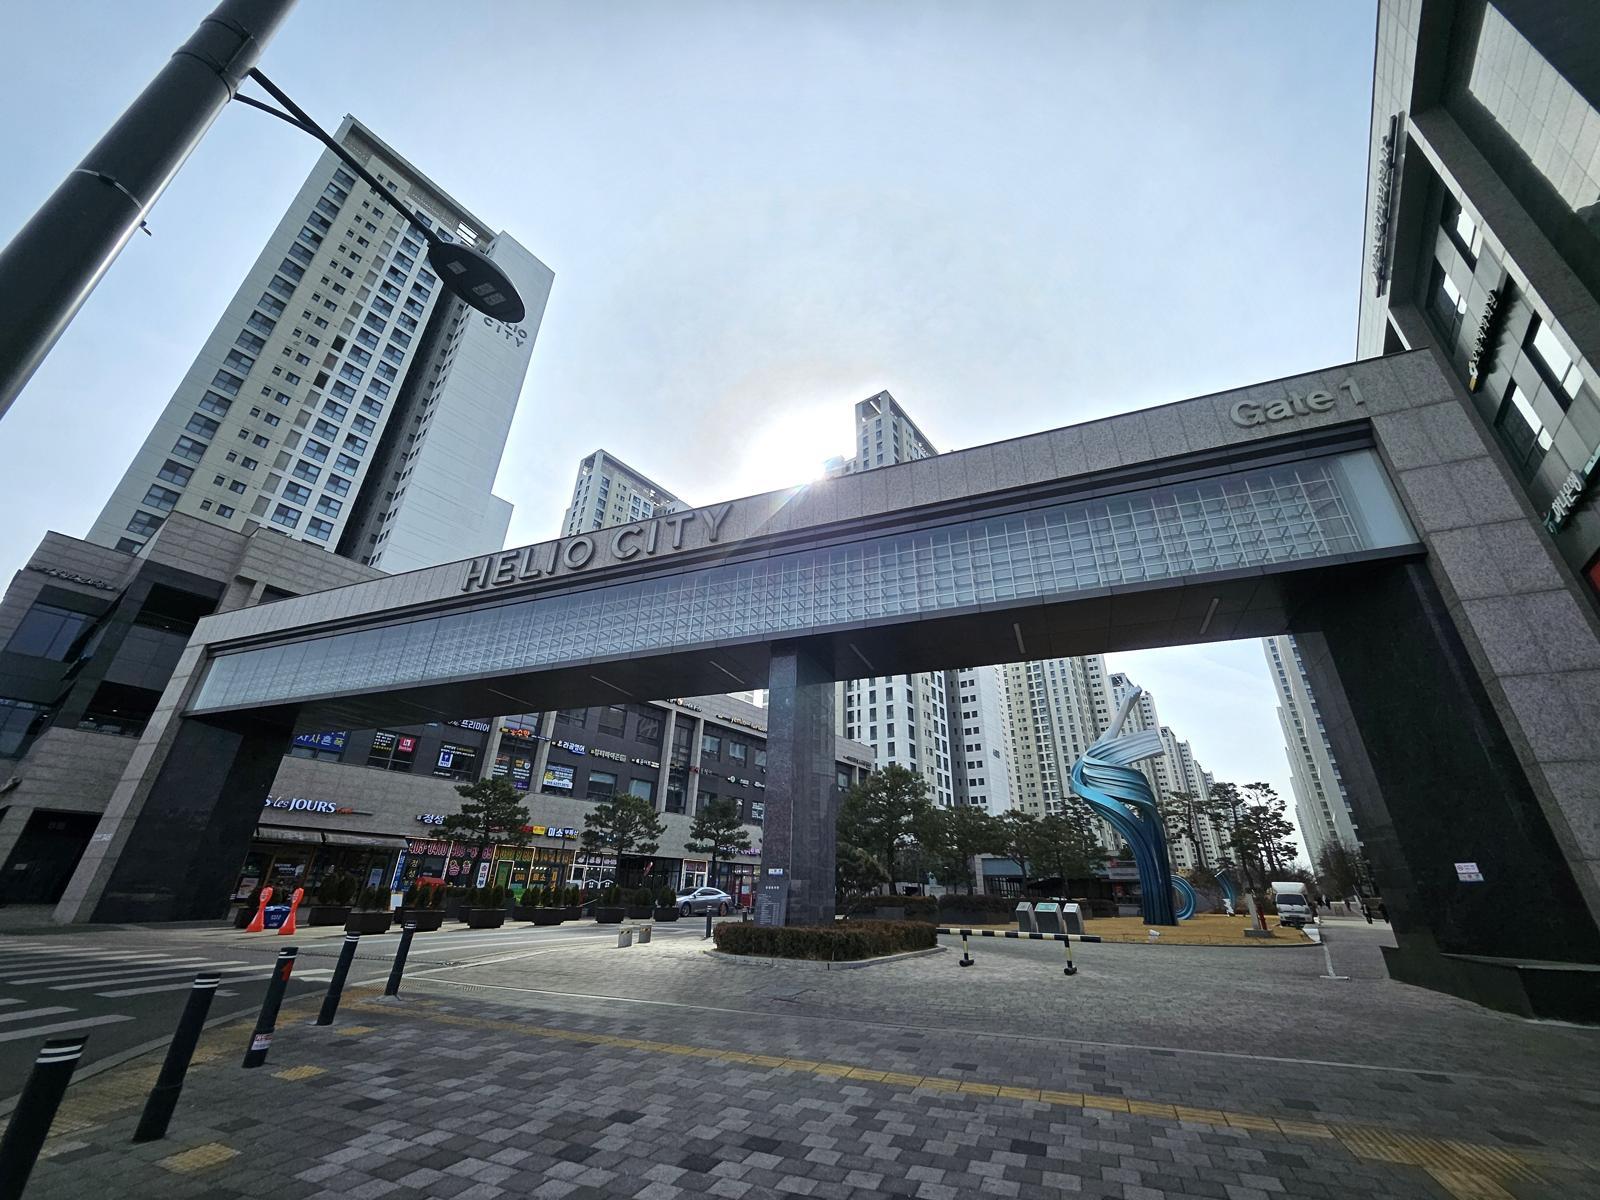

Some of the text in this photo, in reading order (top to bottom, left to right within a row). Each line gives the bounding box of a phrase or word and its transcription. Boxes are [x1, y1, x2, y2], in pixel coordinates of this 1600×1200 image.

[483, 316, 524, 348] CITY
[1229, 376, 1366, 429] Gate 1
[460, 502, 733, 592] HELIO CITY
[273, 796, 289, 808] les
[288, 797, 337, 814] JOURS
[547, 826, 564, 838] 미소
